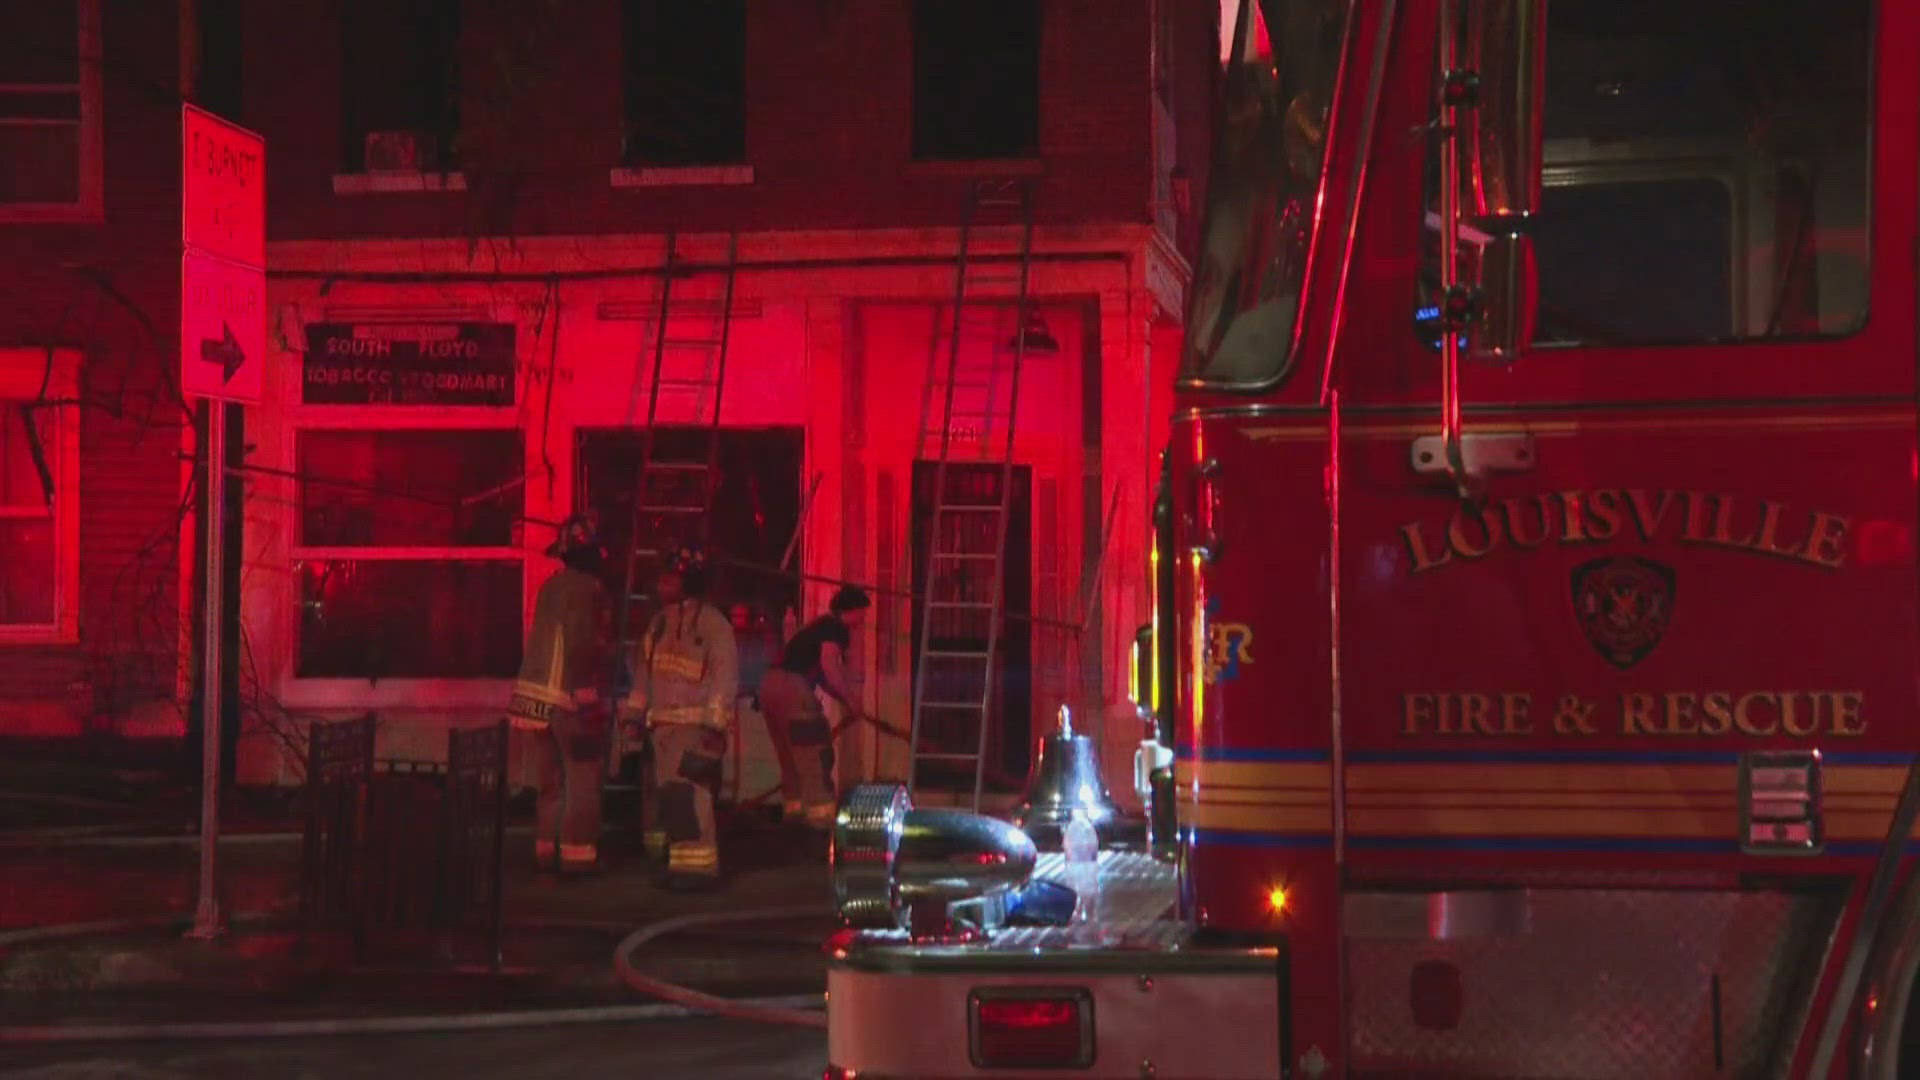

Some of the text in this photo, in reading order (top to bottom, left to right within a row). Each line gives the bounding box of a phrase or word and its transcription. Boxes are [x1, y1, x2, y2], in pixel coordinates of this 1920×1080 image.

[326, 336, 479, 359] SOUTH FLOYD
[1400, 488, 1853, 572] LOUISVILLE
[1402, 691, 1869, 737] FIRE & RESCUE
